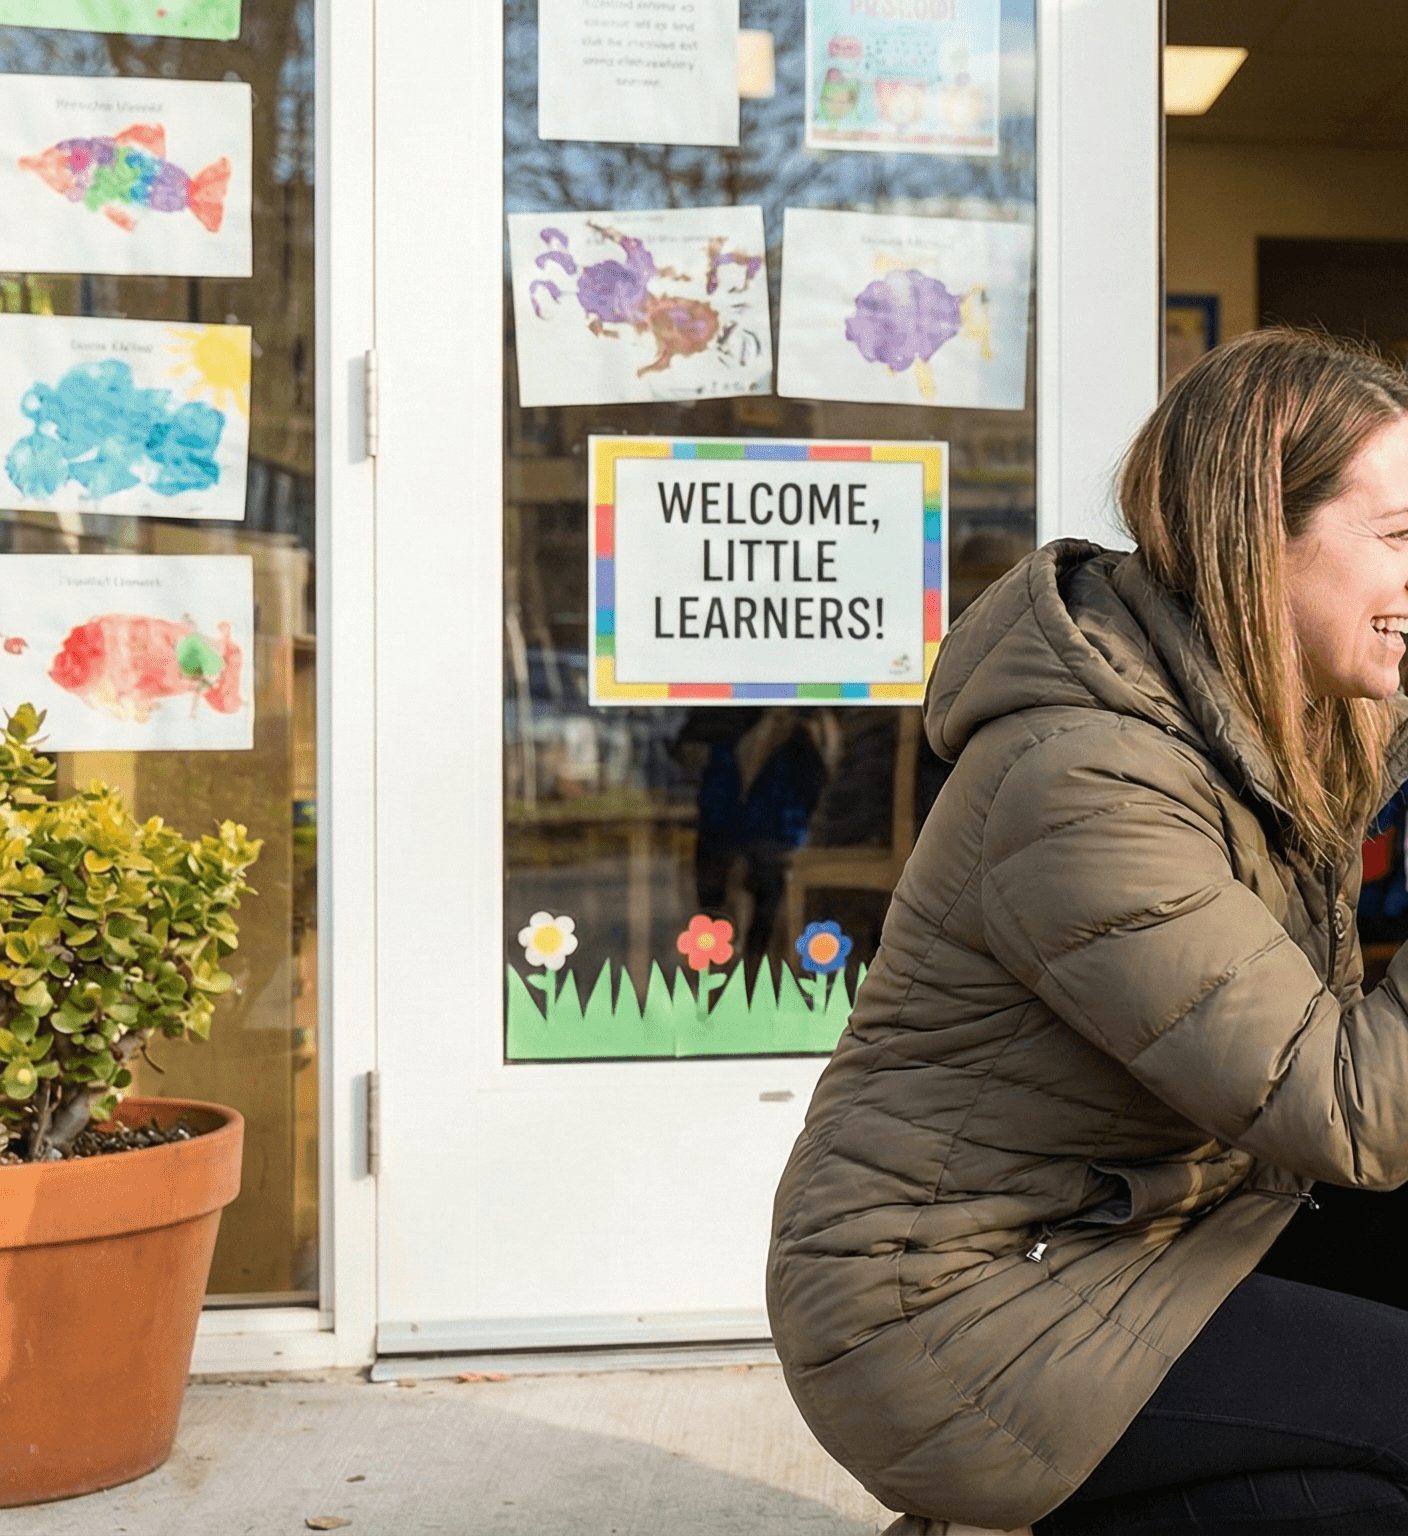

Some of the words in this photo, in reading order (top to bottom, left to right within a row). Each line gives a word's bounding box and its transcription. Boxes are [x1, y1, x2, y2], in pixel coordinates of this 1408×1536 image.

[657, 481, 880, 534] WELCOME,
[703, 539, 838, 582] LITTLE
[654, 596, 885, 641] LEARNERS!
